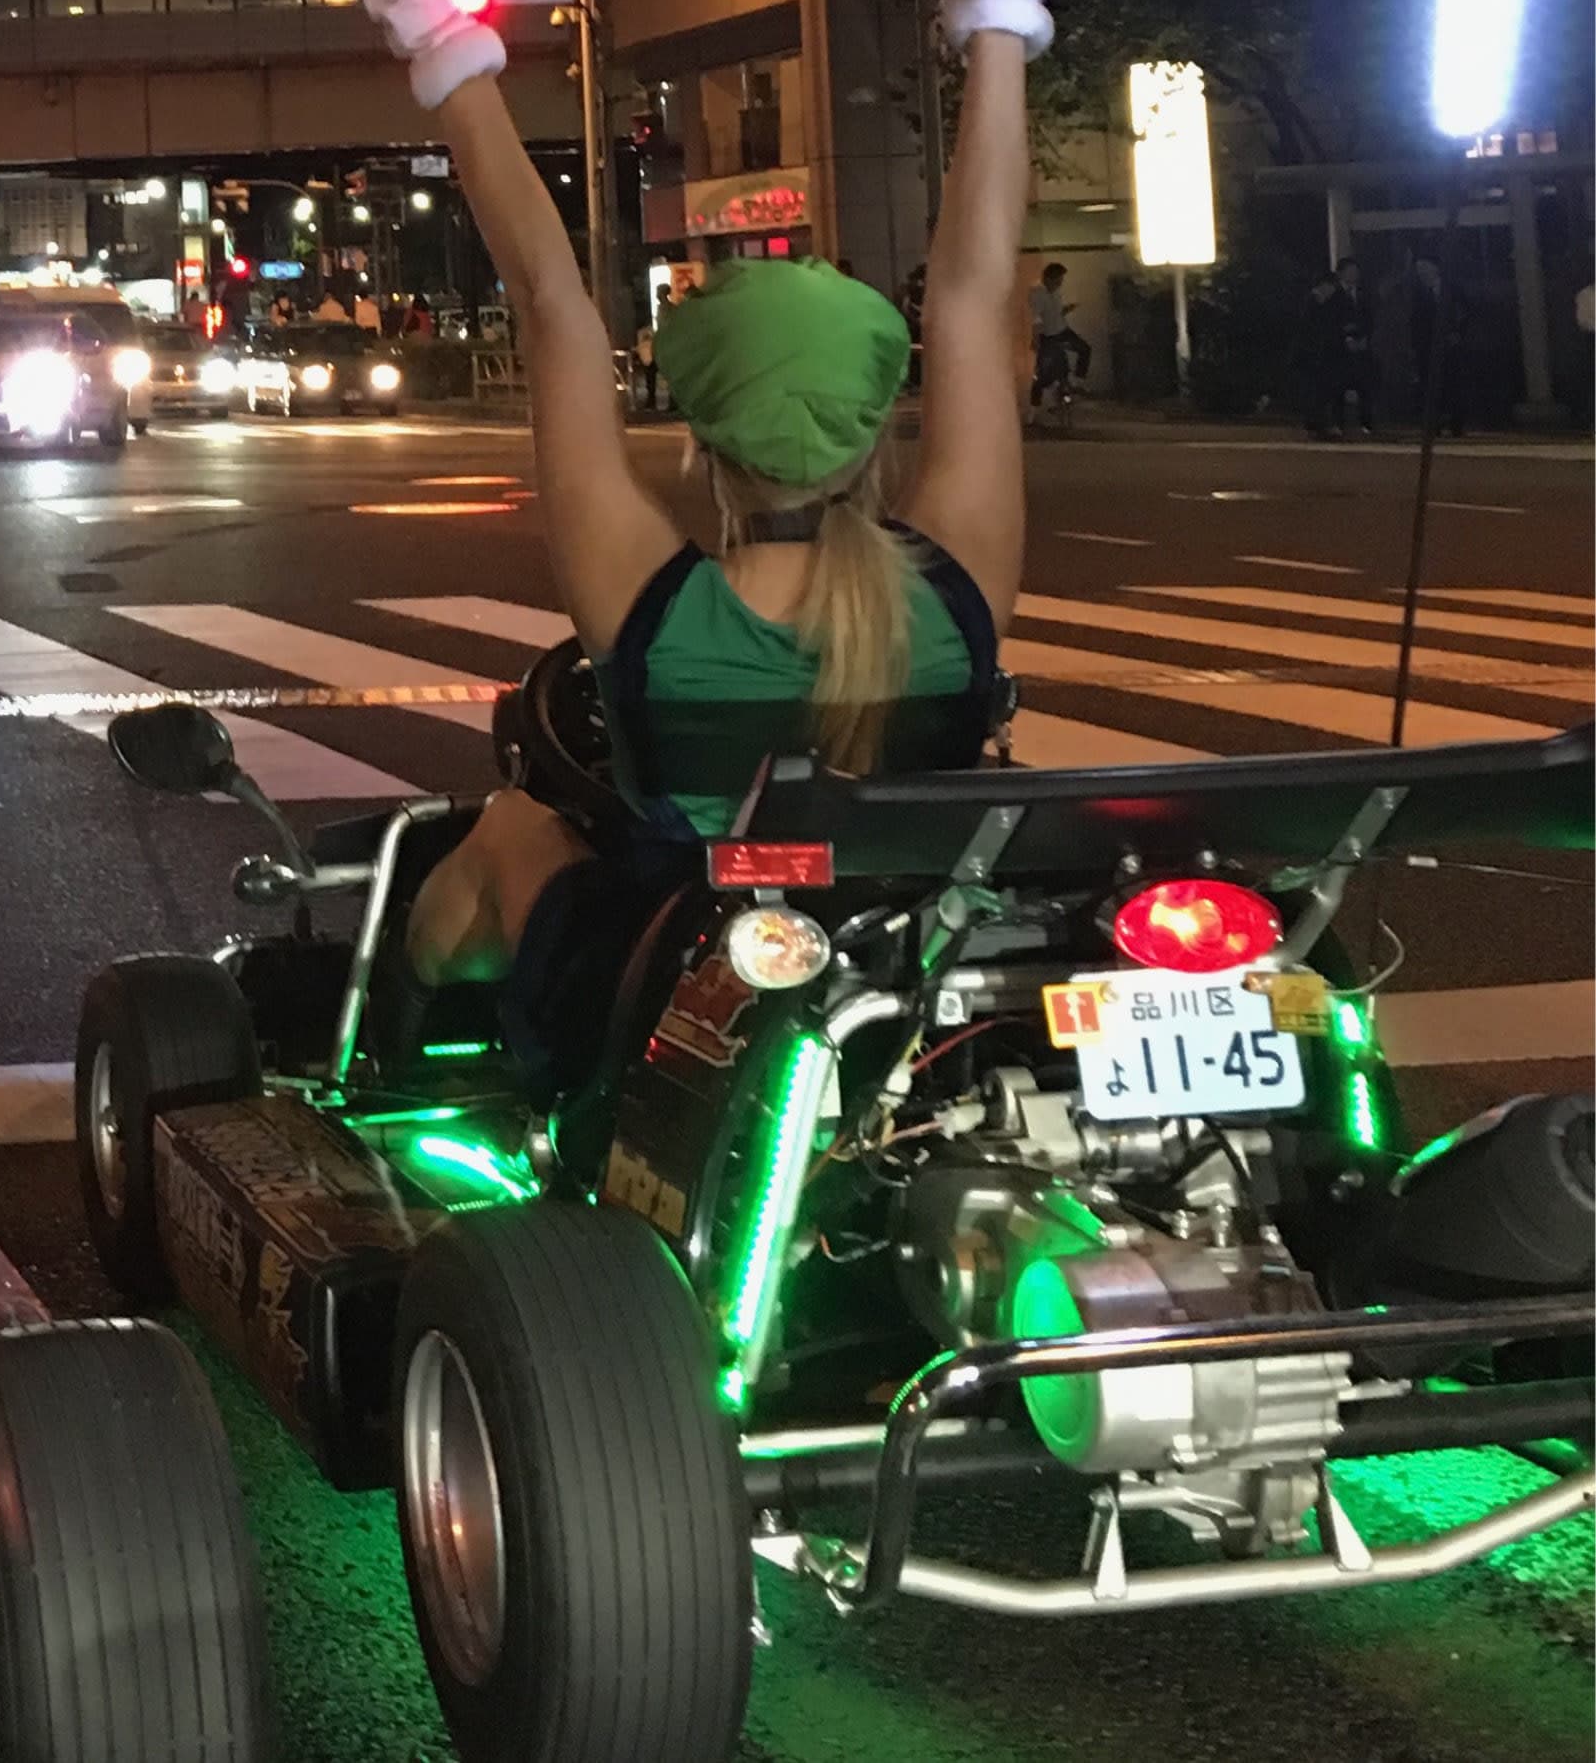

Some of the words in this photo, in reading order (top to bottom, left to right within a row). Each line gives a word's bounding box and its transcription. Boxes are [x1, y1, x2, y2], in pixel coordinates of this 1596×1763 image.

[1132, 986, 1235, 1021] 品川区
[1142, 1031, 1285, 1093] 11-45
